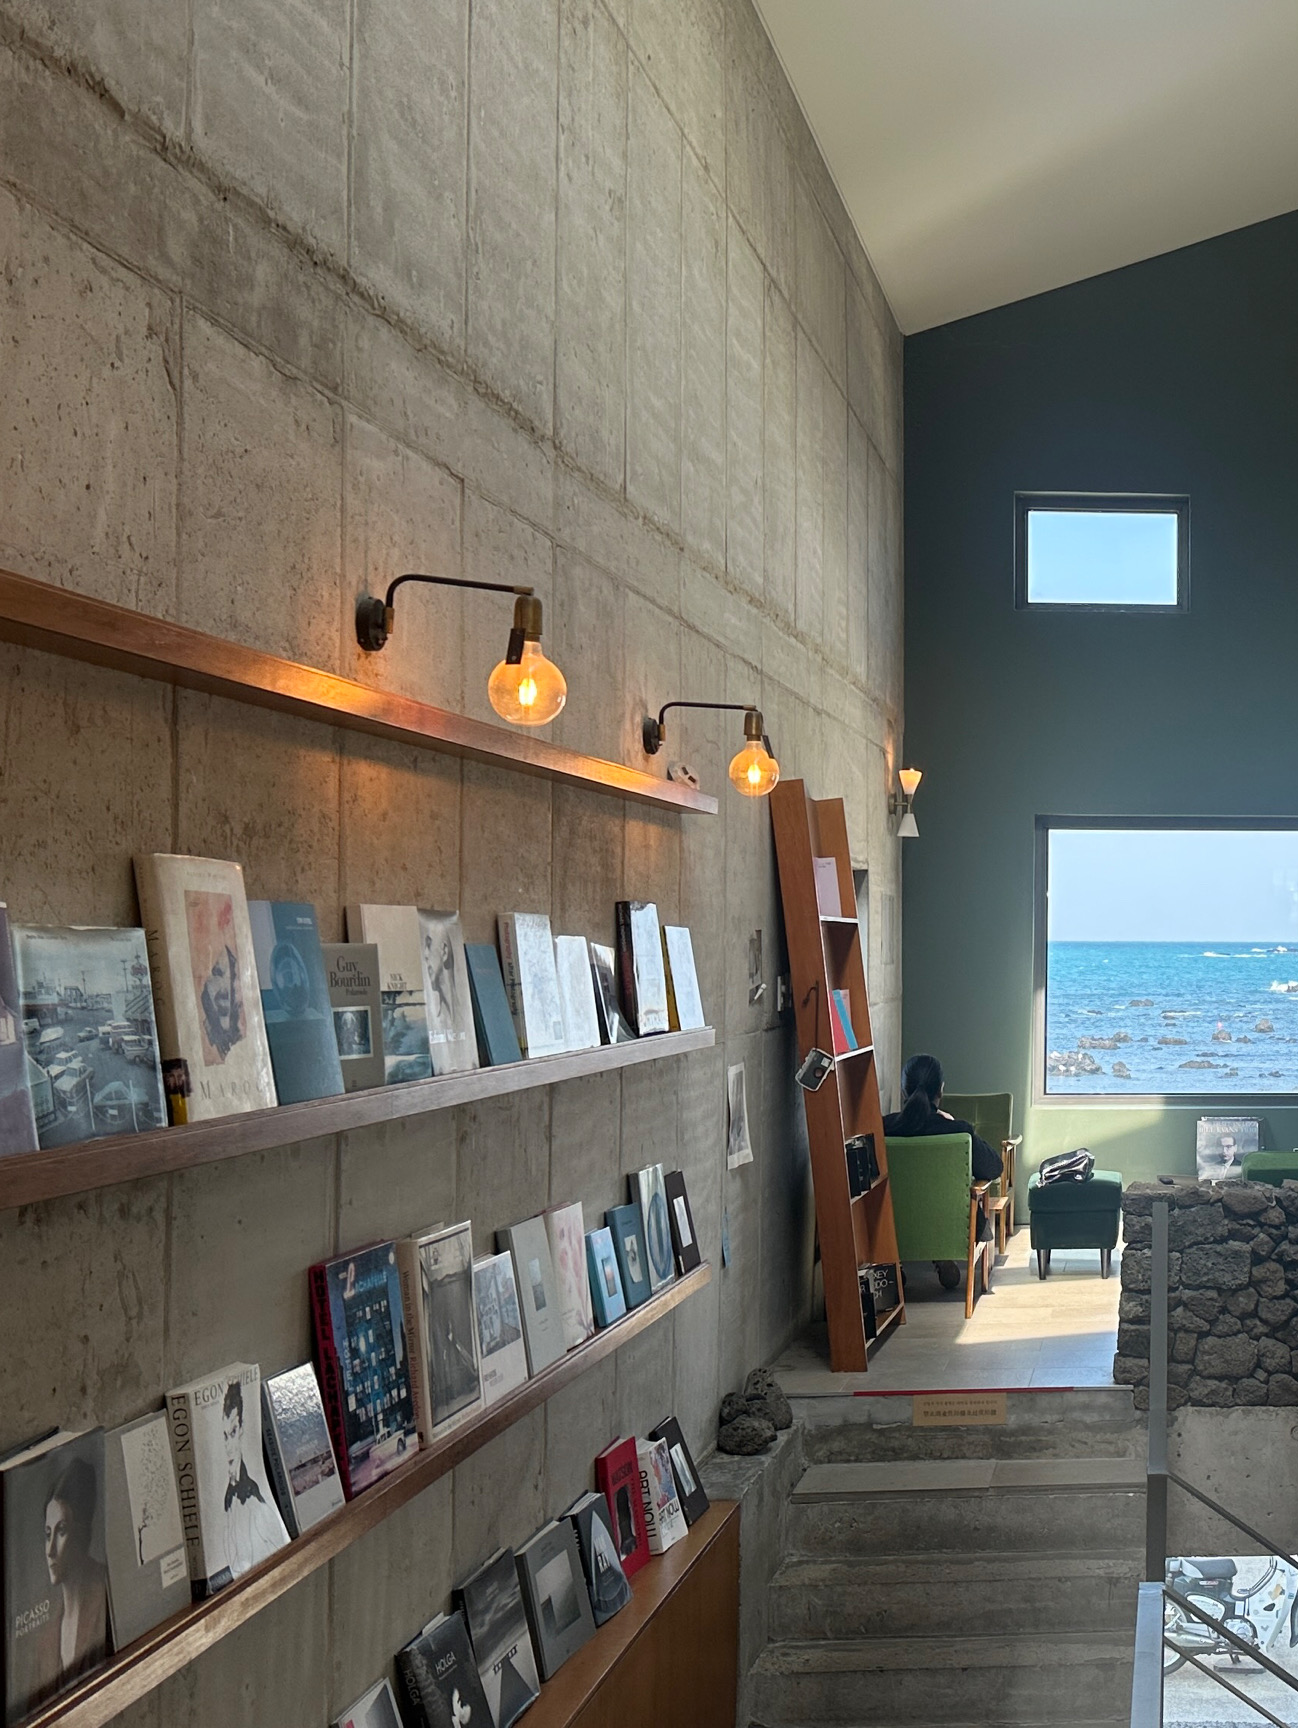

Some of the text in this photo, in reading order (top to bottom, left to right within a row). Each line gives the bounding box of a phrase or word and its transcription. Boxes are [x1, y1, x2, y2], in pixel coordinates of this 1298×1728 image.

[329, 971, 371, 988] Bourdin
[336, 956, 358, 973] Guy
[402, 1270, 411, 1300] Woman
[313, 1269, 331, 1341] HOTEL
[408, 1327, 416, 1354] Mirror
[410, 1356, 419, 1389] Richard
[194, 1380, 224, 1406] EGON
[171, 1395, 200, 1547] EGON SCHIELE
[639, 1470, 657, 1538] ART NOW
[15, 1599, 50, 1629] PICASSO
[434, 1651, 456, 1676] HOLGA
[403, 1670, 420, 1706] HOLGA
